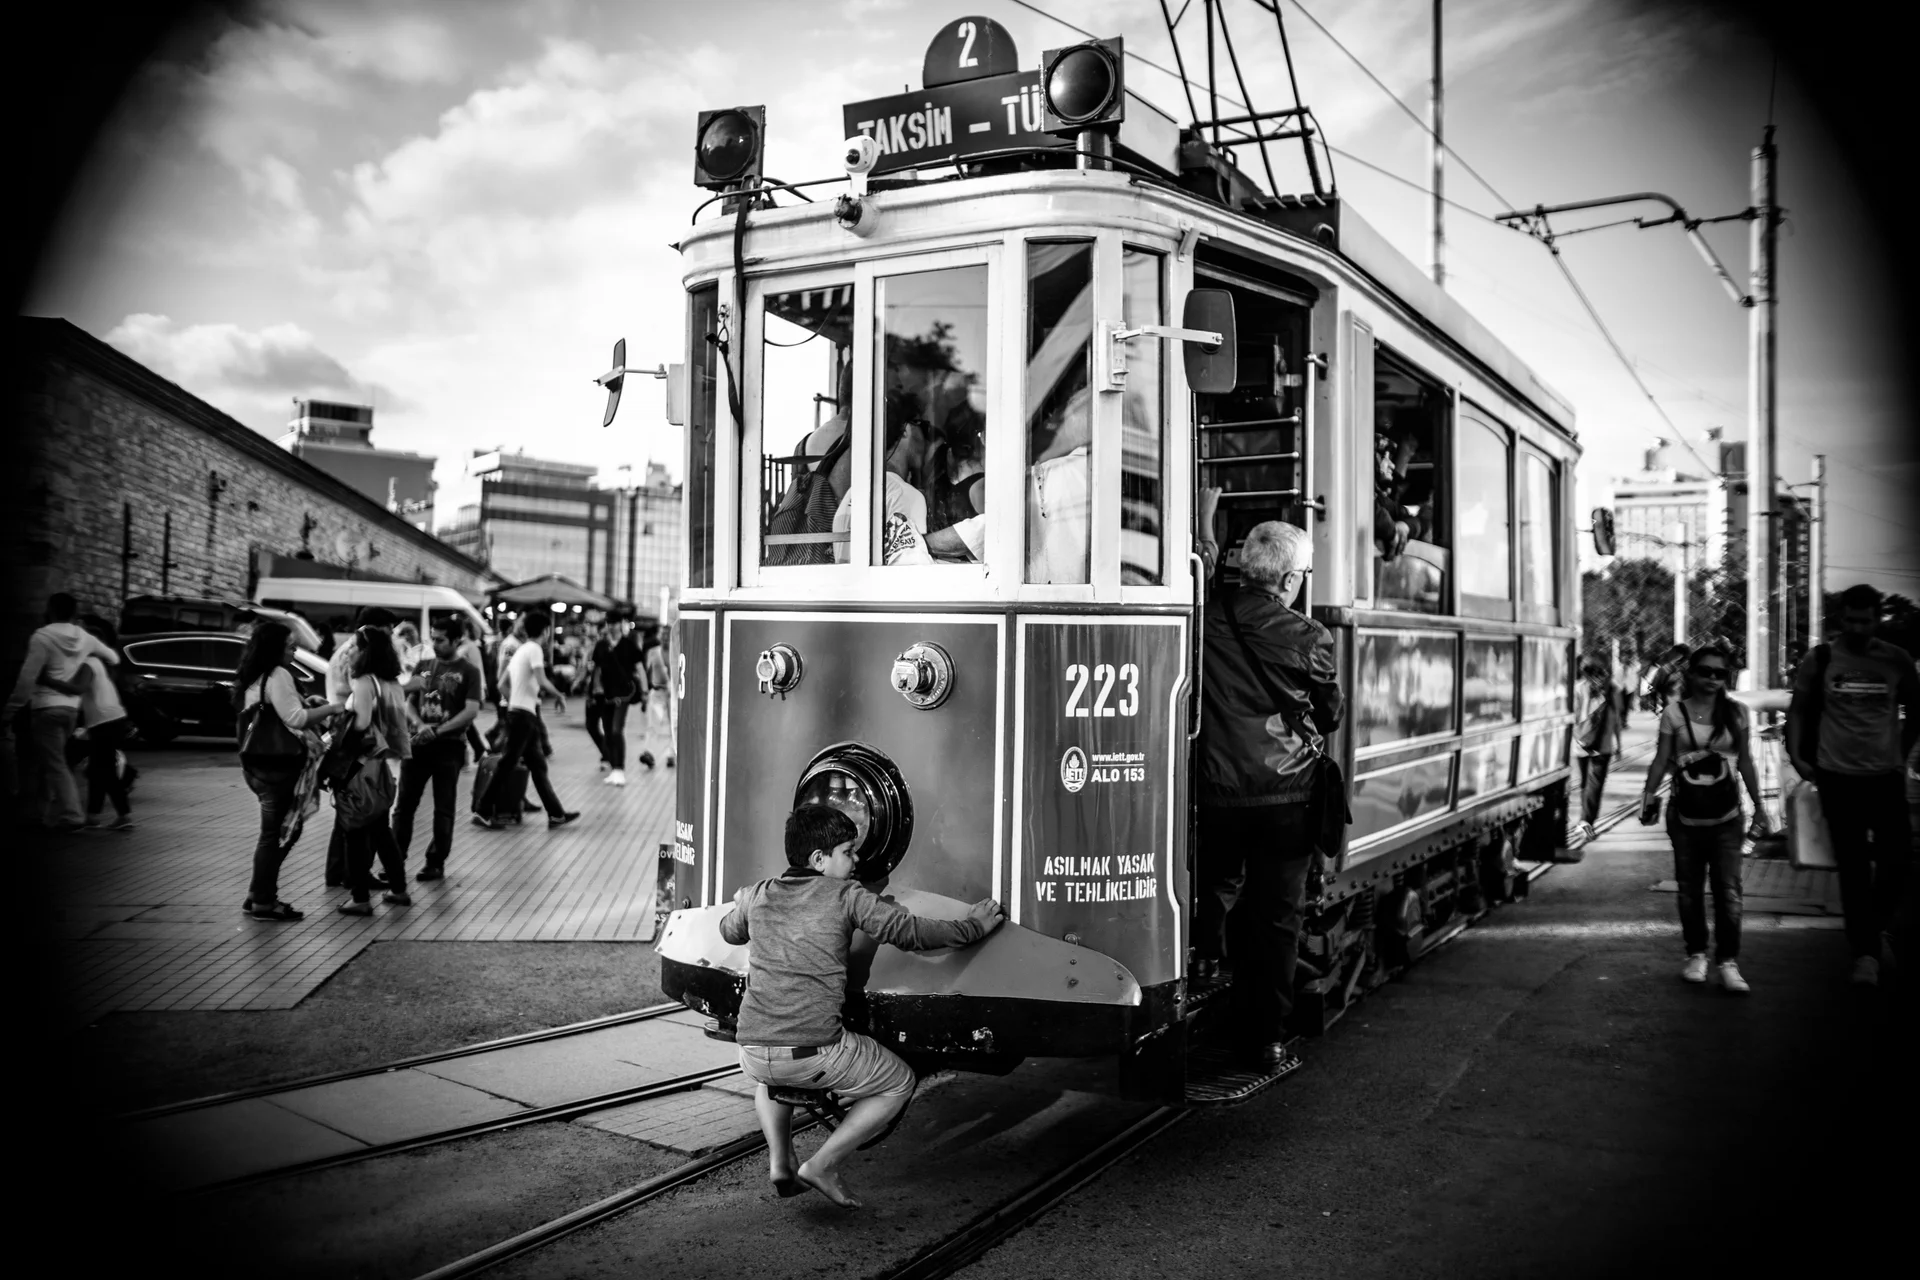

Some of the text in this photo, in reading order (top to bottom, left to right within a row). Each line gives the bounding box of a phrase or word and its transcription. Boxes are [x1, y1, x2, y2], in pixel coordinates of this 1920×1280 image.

[958, 21, 978, 68] 2
[1065, 663, 1140, 718] 223
[1091, 767, 1145, 782] ALO 153
[1043, 853, 1155, 876] ASILMAK YASAK
[1035, 876, 1157, 903] VE TEHLİKELİDİR
